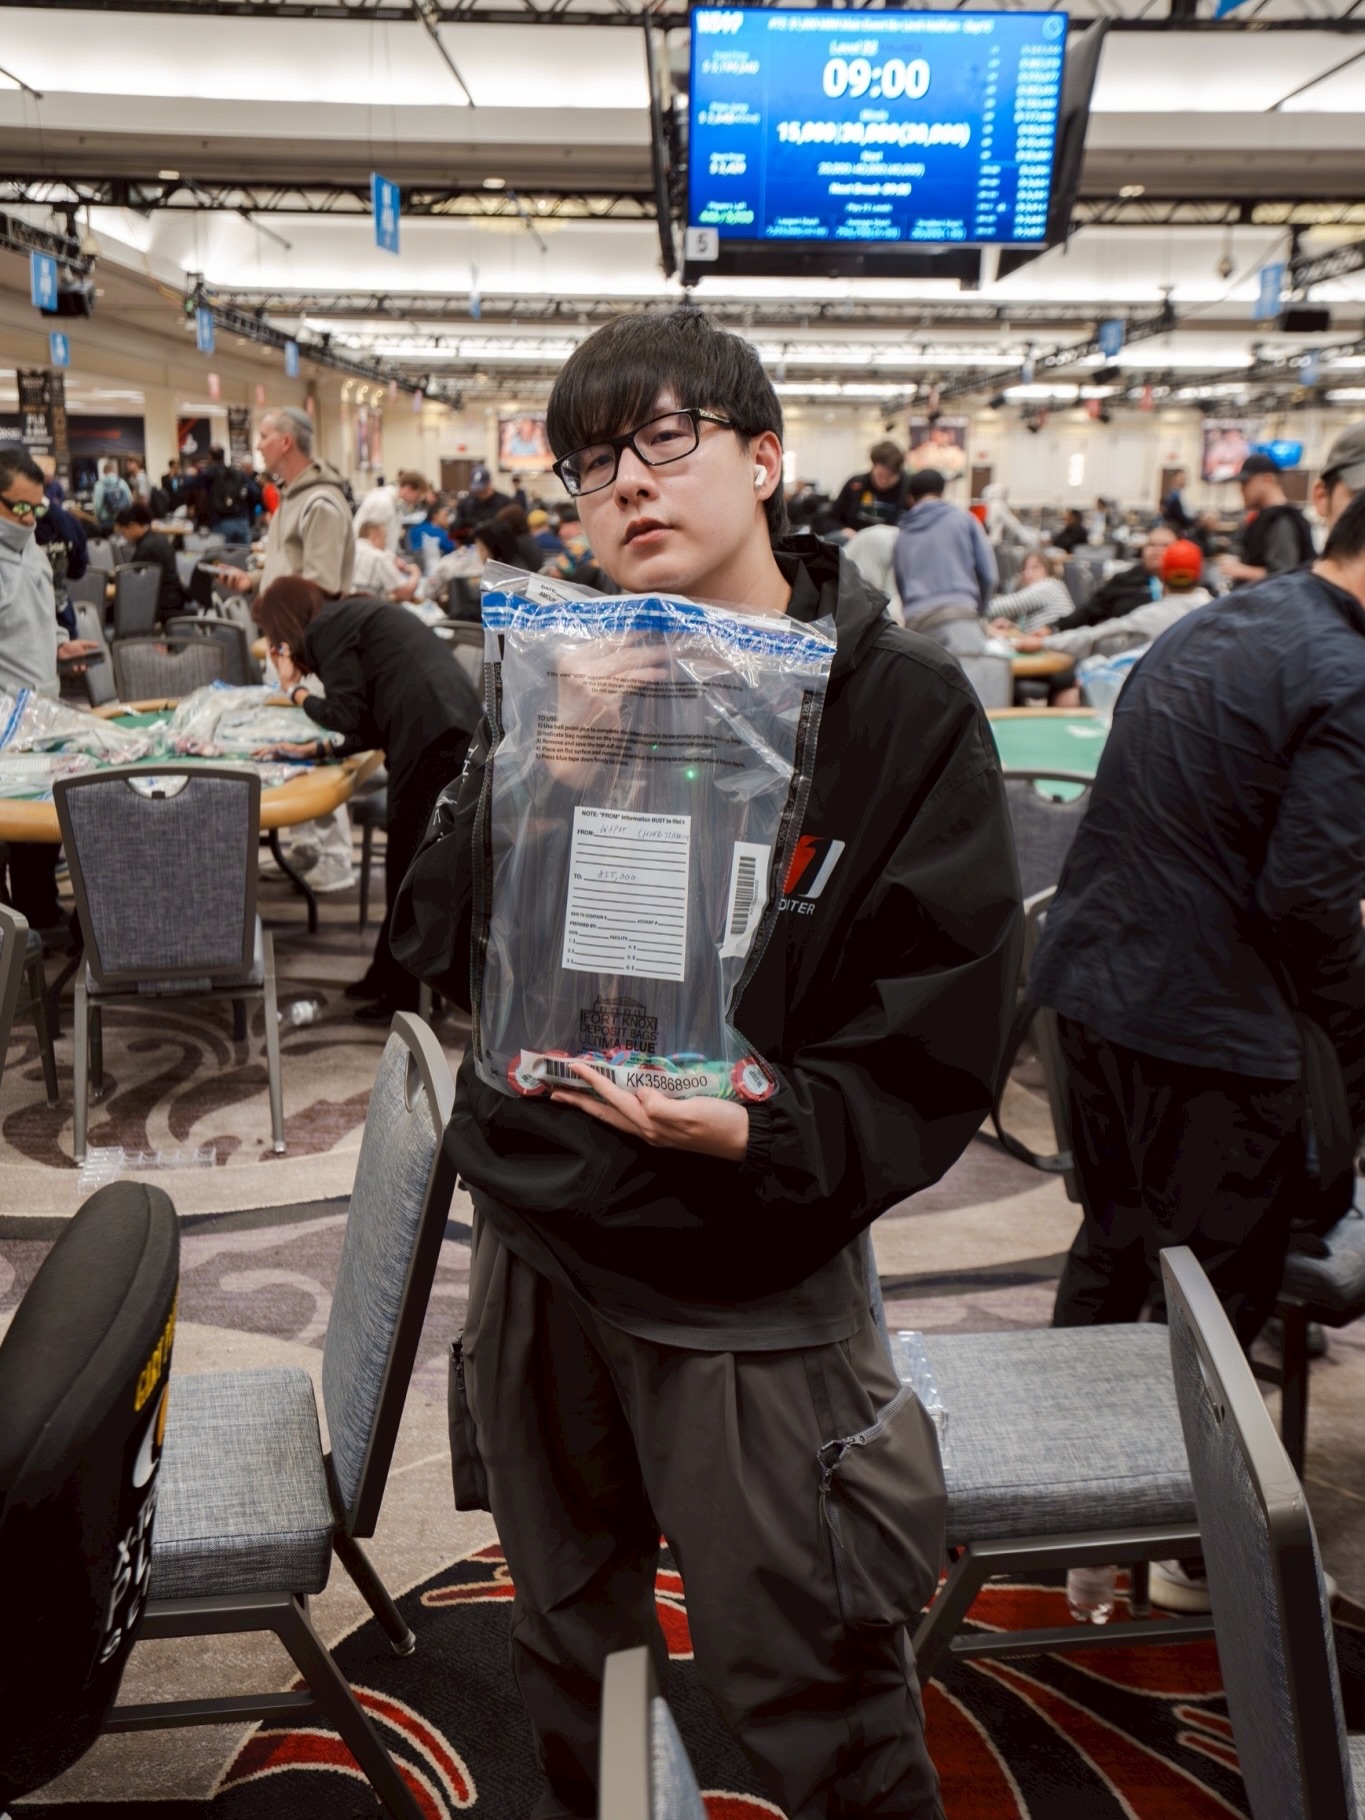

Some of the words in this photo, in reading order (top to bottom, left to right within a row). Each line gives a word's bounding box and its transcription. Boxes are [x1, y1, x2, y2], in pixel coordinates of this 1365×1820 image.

[822, 57, 932, 100] 09:00
[697, 232, 709, 254] 5
[599, 812, 621, 820] "FROM"
[573, 872, 583, 880] TO:
[597, 869, 637, 883] 855,000
[569, 920, 590, 928] PREPARED
[583, 1012, 618, 1025] FORT
[621, 1016, 654, 1031] KNOX
[580, 1023, 628, 1038] DEPOSIT
[629, 1028, 657, 1041] BAGS
[580, 1033, 621, 1049] ULTIMA
[625, 1039, 656, 1055] BLUE
[625, 1071, 708, 1092] KK35868900
